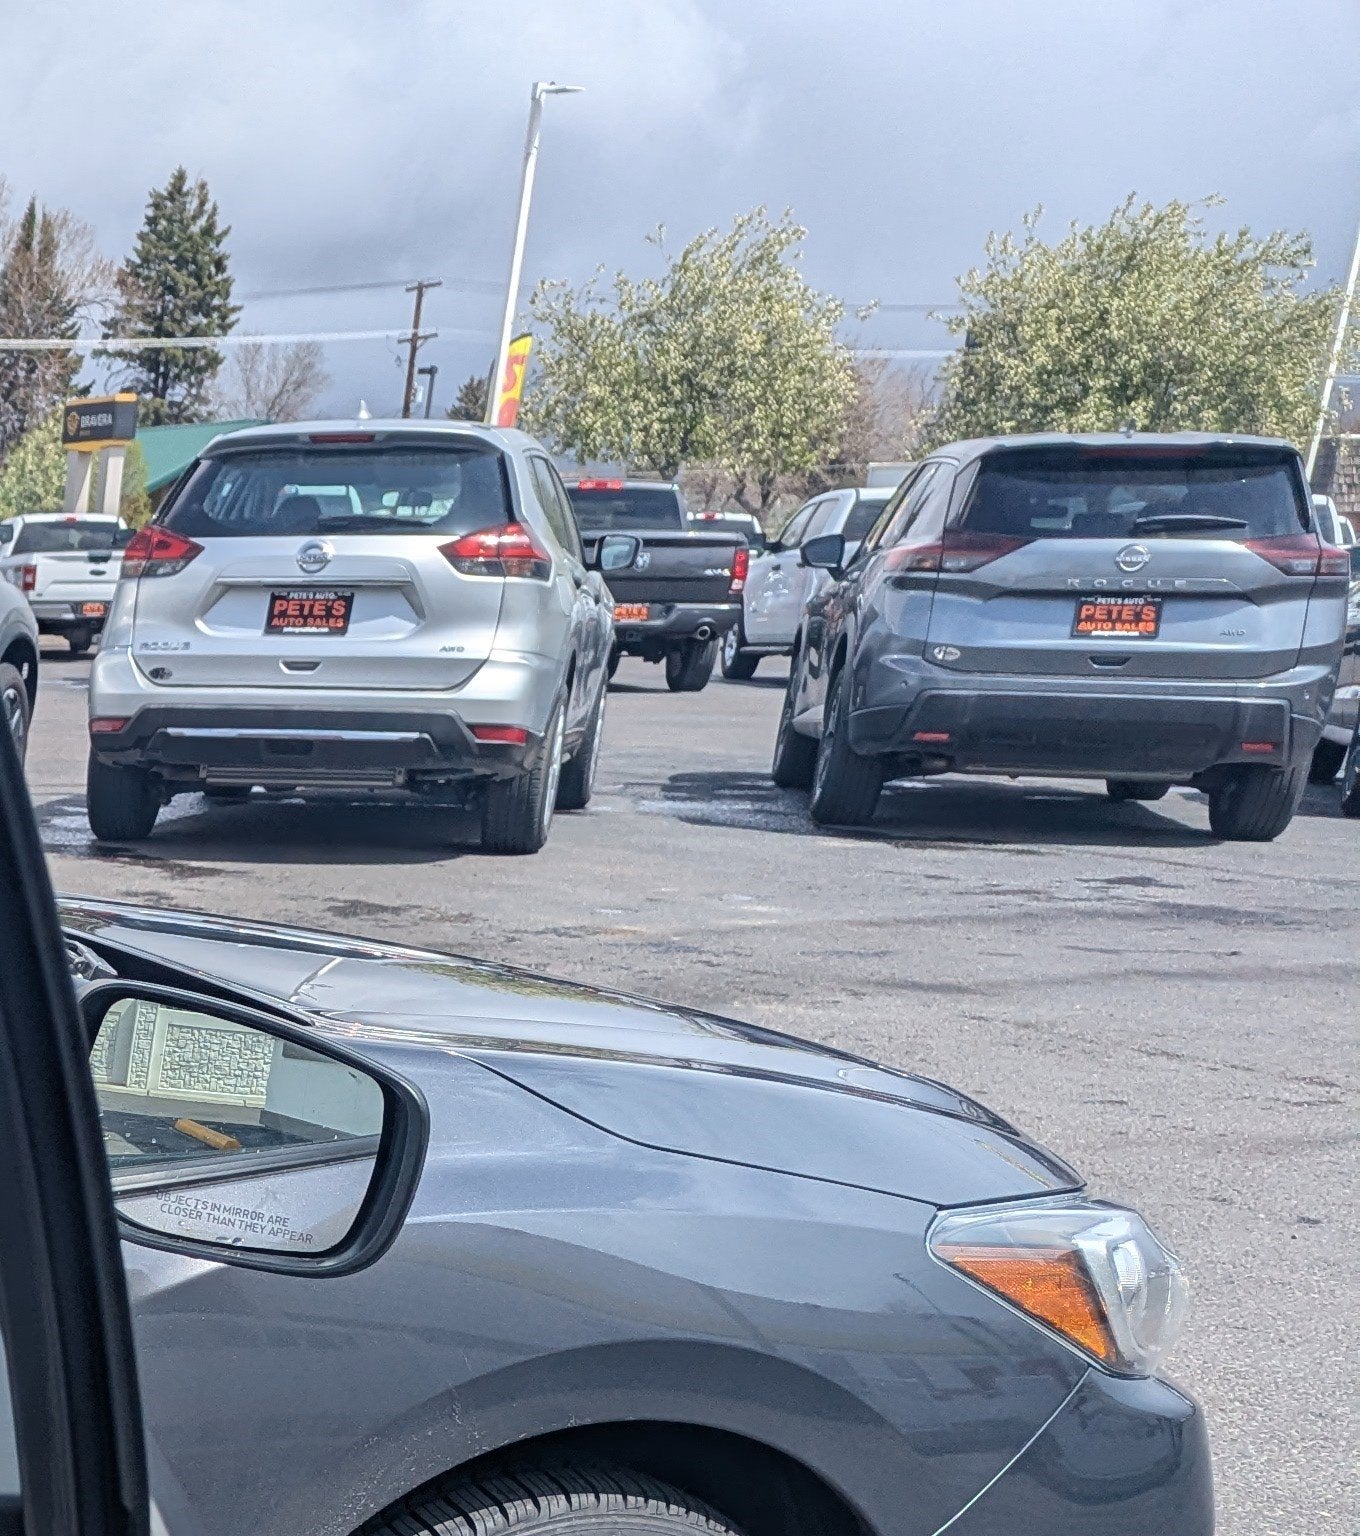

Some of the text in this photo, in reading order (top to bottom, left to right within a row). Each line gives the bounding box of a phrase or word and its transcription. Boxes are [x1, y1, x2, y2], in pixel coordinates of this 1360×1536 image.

[274, 600, 346, 616] PETE'S
[1080, 605, 1156, 620] PETE'S
[156, 1192, 290, 1228] OBJECTS IN MIRROR ARE
[160, 1203, 314, 1244] CLOSER THAN THEY APPEAR
